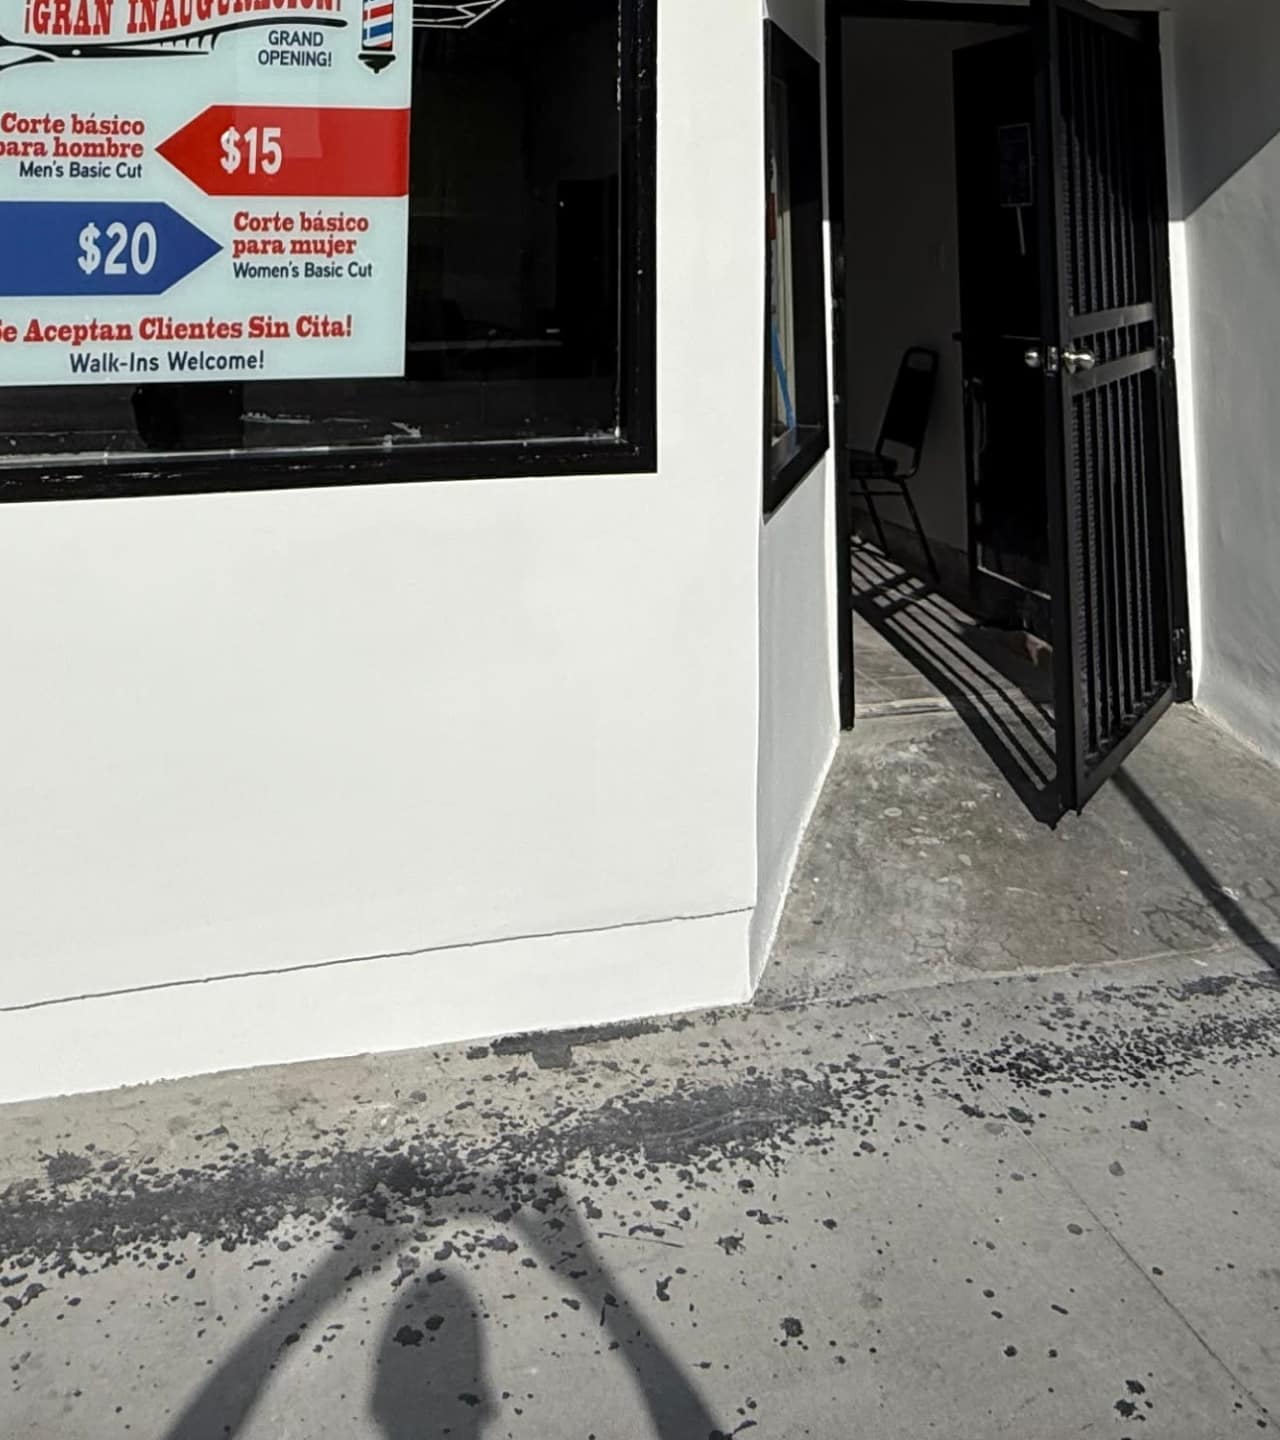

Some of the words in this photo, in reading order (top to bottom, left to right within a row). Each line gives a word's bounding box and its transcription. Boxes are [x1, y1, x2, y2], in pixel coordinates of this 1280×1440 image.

[268, 30, 324, 47] GRAND
[257, 49, 333, 68] OPENING!
[0, 112, 65, 135] Corte
[71, 112, 145, 136] básico
[52, 136, 144, 158] hombre
[220, 125, 283, 176] $15
[19, 161, 64, 178] Men's
[69, 162, 111, 178] Basic
[116, 162, 143, 179] Cut
[233, 211, 294, 233] Corte
[300, 210, 369, 233] básico
[77, 221, 158, 275] $20
[232, 238, 285, 258] para
[289, 235, 357, 258] mujer
[232, 261, 300, 279] Women's
[304, 261, 343, 278] Basic
[347, 261, 373, 278] Cut
[23, 317, 133, 346] Aceptan
[139, 316, 243, 340] Clientes
[248, 315, 290, 339] Sin
[296, 314, 352, 338] Cita!
[70, 351, 160, 373] Walk-Ins
[168, 349, 265, 371] Welcome!
